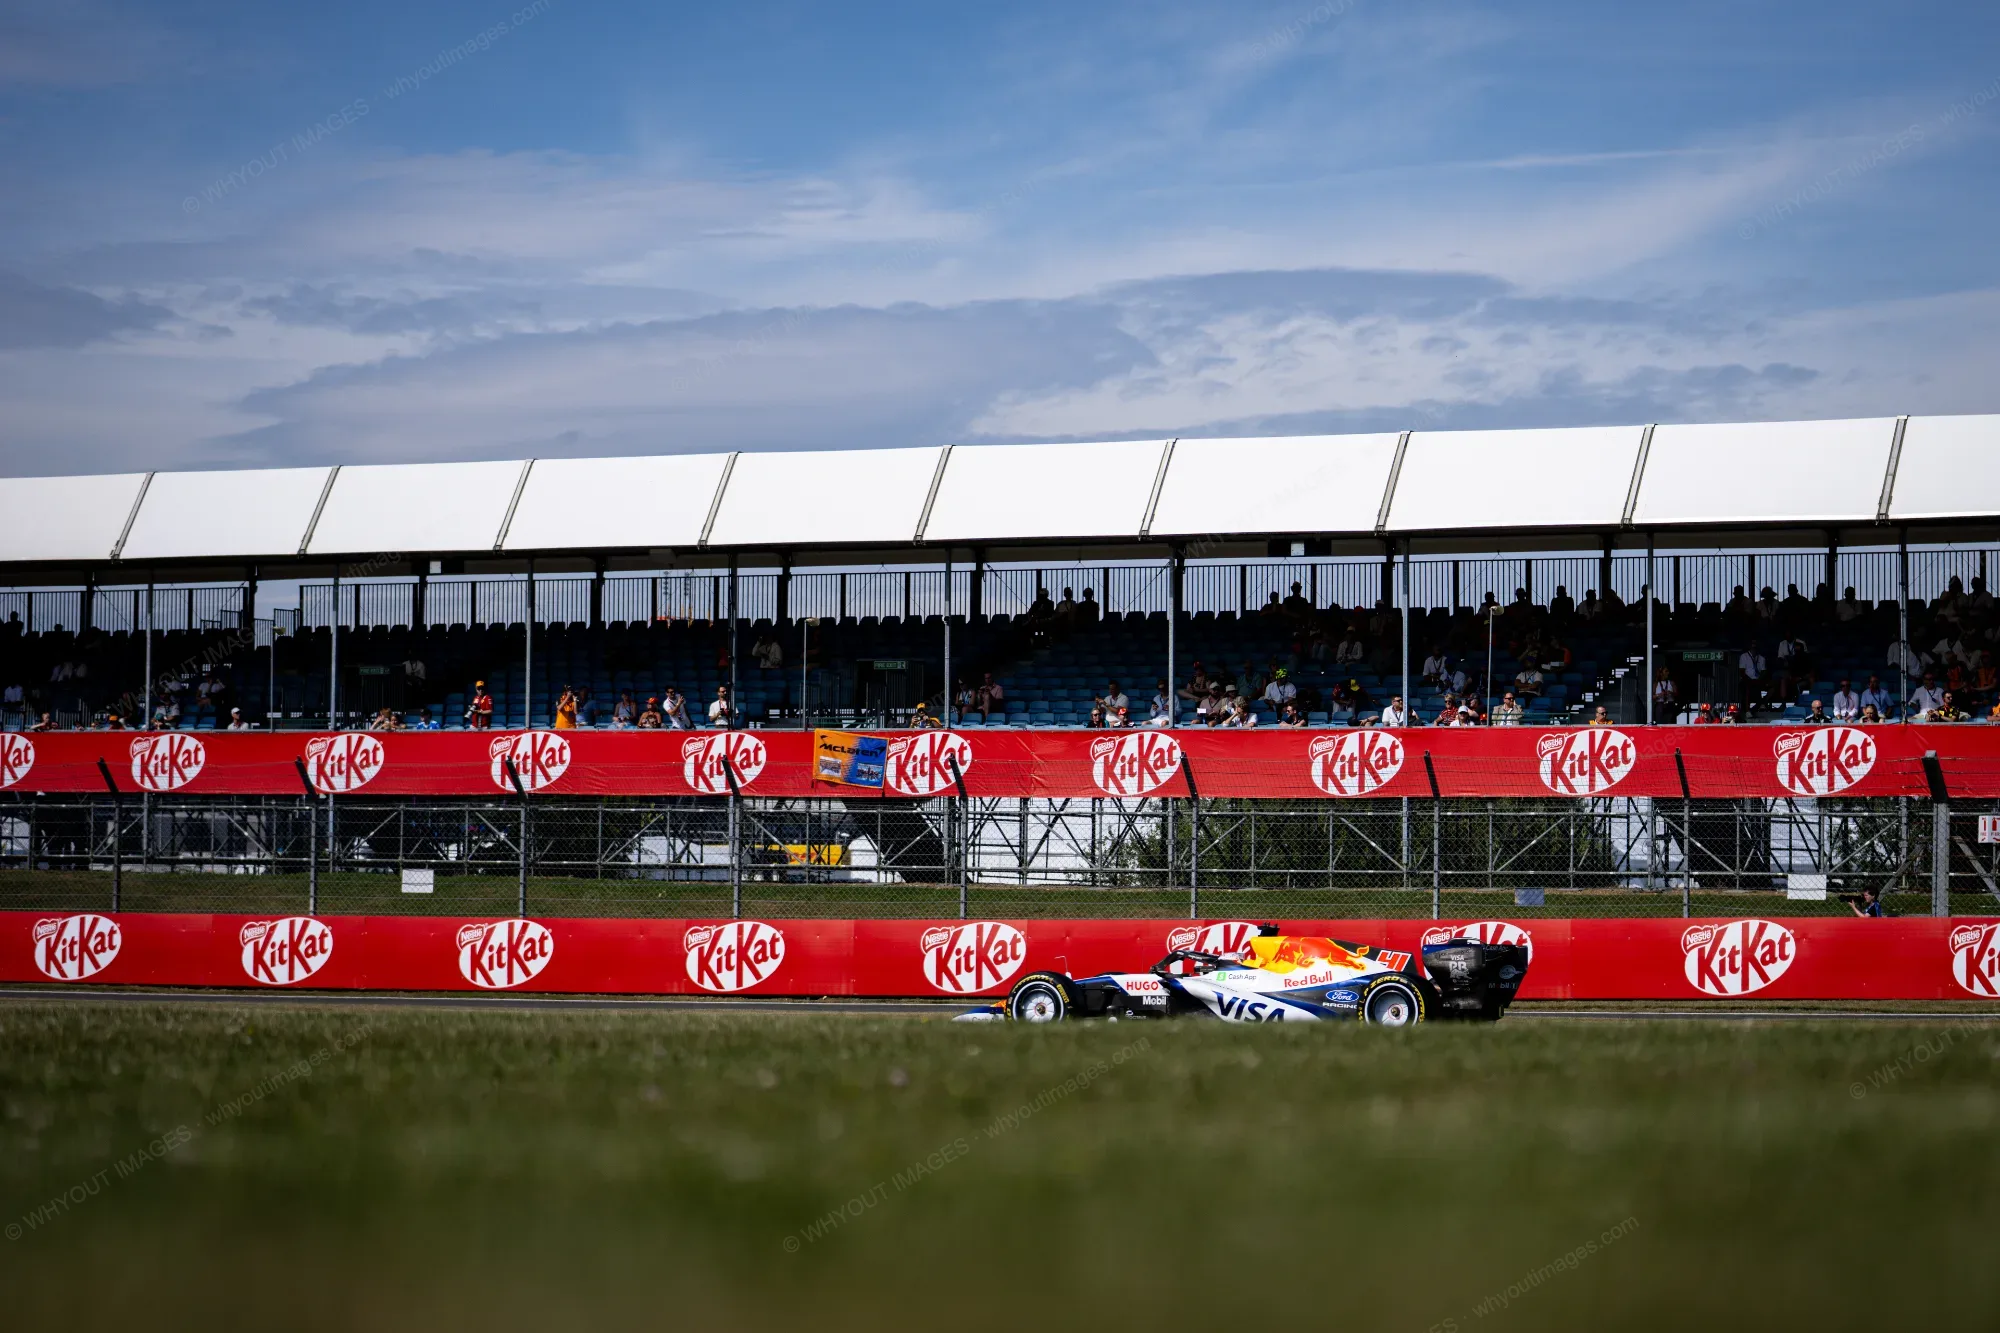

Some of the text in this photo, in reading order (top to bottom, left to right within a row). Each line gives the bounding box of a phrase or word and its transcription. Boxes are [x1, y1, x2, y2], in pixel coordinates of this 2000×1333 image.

[141, 735, 202, 790] KitKat
[316, 735, 381, 791] KitKat
[501, 733, 567, 789] KitKat
[694, 734, 763, 792] KitKat
[820, 743, 879, 758] McLaren
[1103, 733, 1177, 794] KitKat
[1322, 732, 1400, 794] KitKat
[1551, 731, 1632, 793] KitKat
[1788, 729, 1872, 794] KitKat
[45, 916, 118, 979] KitKat
[253, 919, 329, 983] KitKat
[470, 921, 550, 986] KitKat
[698, 923, 781, 990] KitKat
[936, 924, 1022, 992] KitKat
[1698, 922, 1791, 994] KitKat
[1126, 981, 1159, 991] HUGO
[1213, 990, 1286, 1023] VISA
[1284, 970, 1333, 988] Red Bull
[1331, 991, 1353, 1001] Ford
